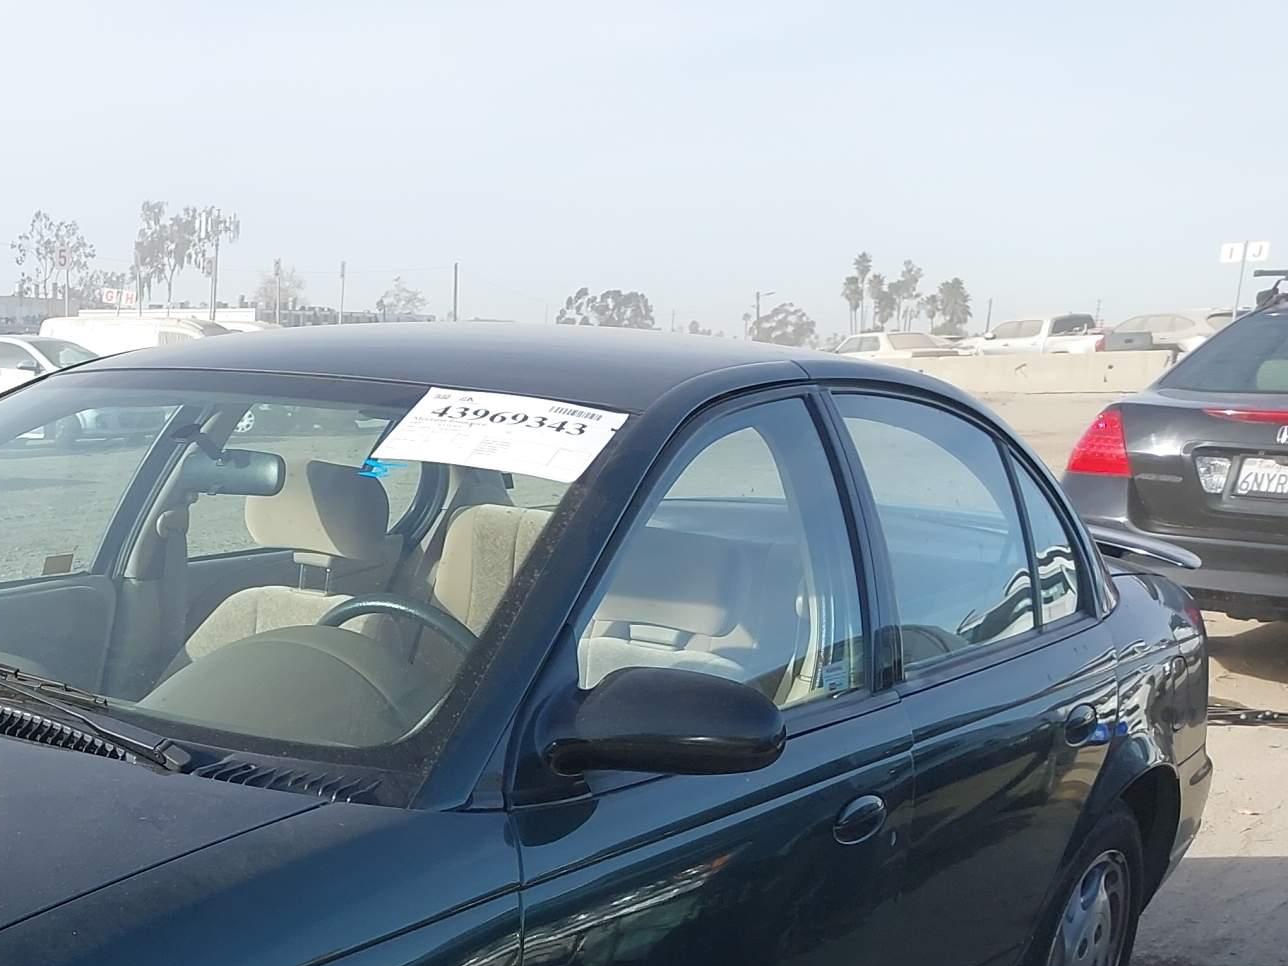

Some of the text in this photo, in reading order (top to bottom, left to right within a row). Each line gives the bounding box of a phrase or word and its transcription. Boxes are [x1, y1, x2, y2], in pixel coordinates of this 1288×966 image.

[59, 249, 67, 267] 5
[1252, 244, 1263, 258] J
[105, 290, 114, 302] G
[125, 292, 134, 305] H
[432, 405, 588, 435] 43969343
